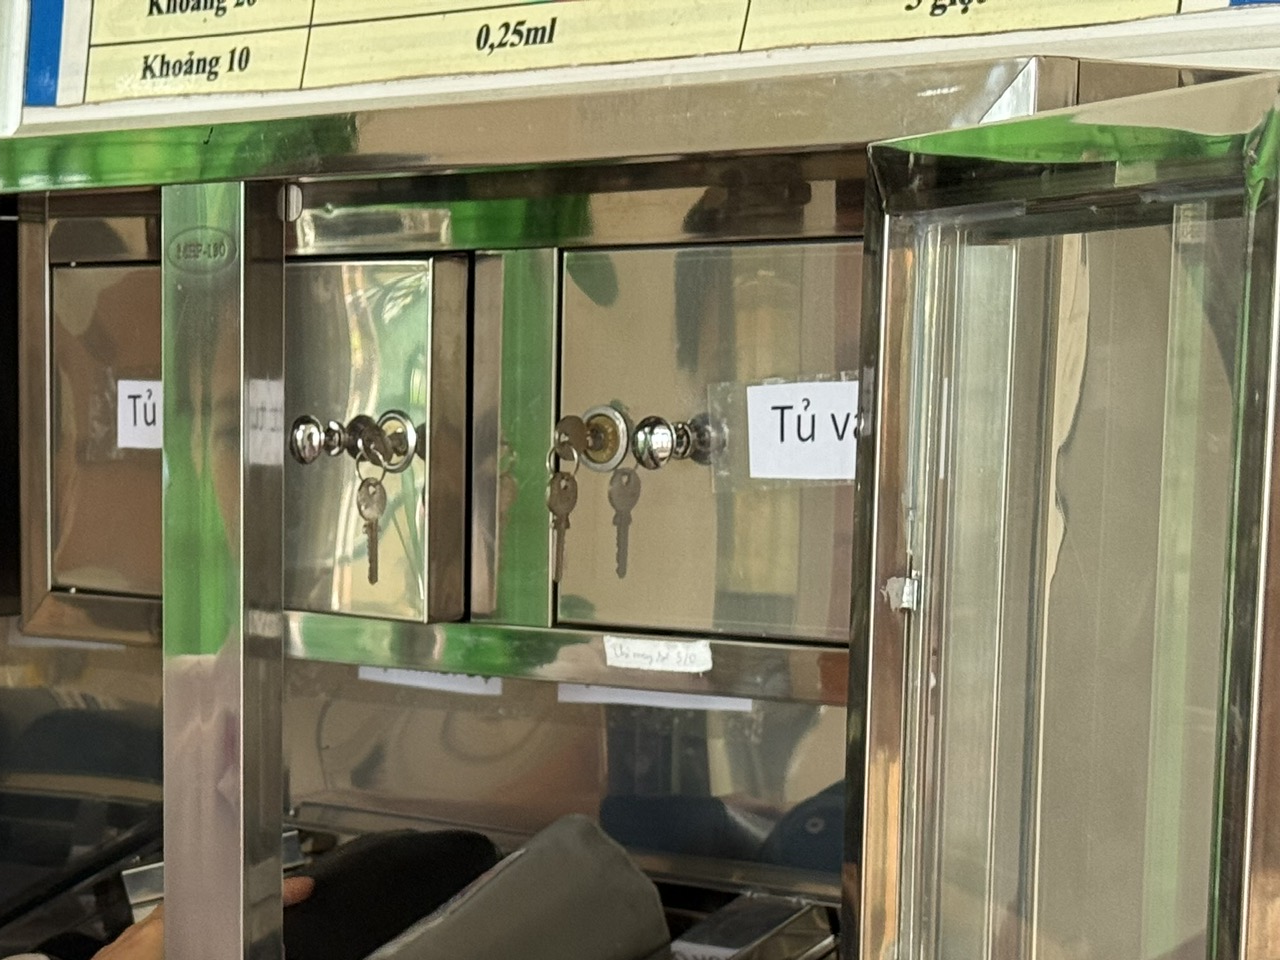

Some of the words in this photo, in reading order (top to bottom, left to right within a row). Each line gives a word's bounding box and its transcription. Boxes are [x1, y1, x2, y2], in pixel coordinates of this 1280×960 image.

[476, 17, 558, 57] 0,25ml
[140, 50, 222, 82] Khoảng
[226, 46, 251, 73] 10
[127, 388, 157, 427] Tủ
[771, 397, 816, 443] Tủ
